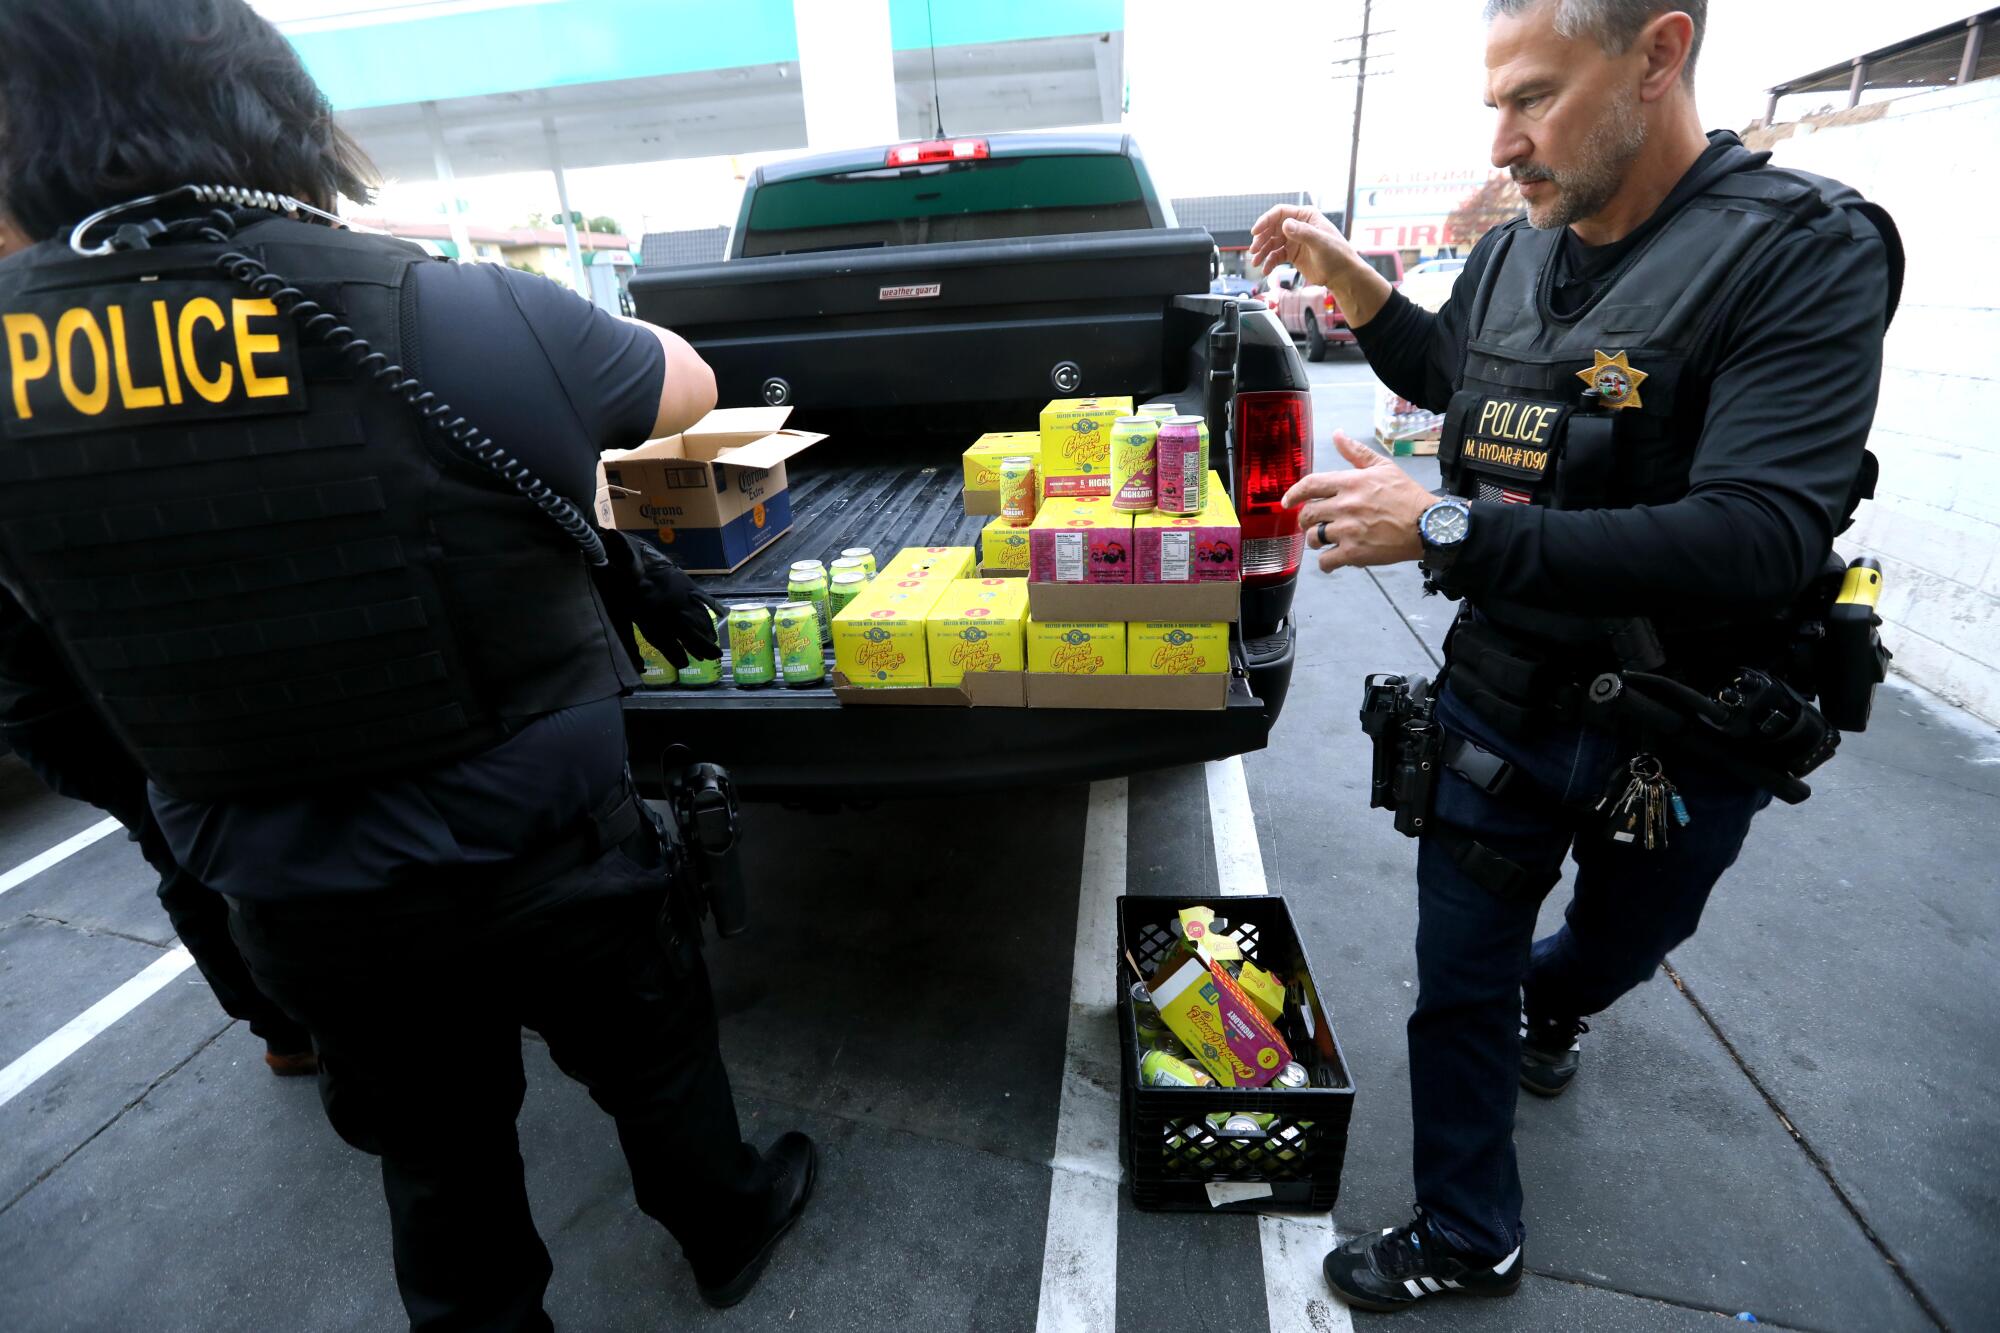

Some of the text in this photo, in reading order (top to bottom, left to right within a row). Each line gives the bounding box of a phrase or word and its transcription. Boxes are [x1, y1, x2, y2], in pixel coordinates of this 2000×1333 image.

[881, 285, 938, 297] weather guard
[2, 297, 290, 420] POLICE
[1478, 400, 1558, 443] POLICE
[1464, 439, 1476, 457] M.
[738, 468, 769, 493] Corona
[976, 470, 1000, 485] Chee
[1088, 478, 1110, 487] HIGH&
[640, 504, 684, 519] Corona
[1226, 1010, 1255, 1040] HIGH&DRY
